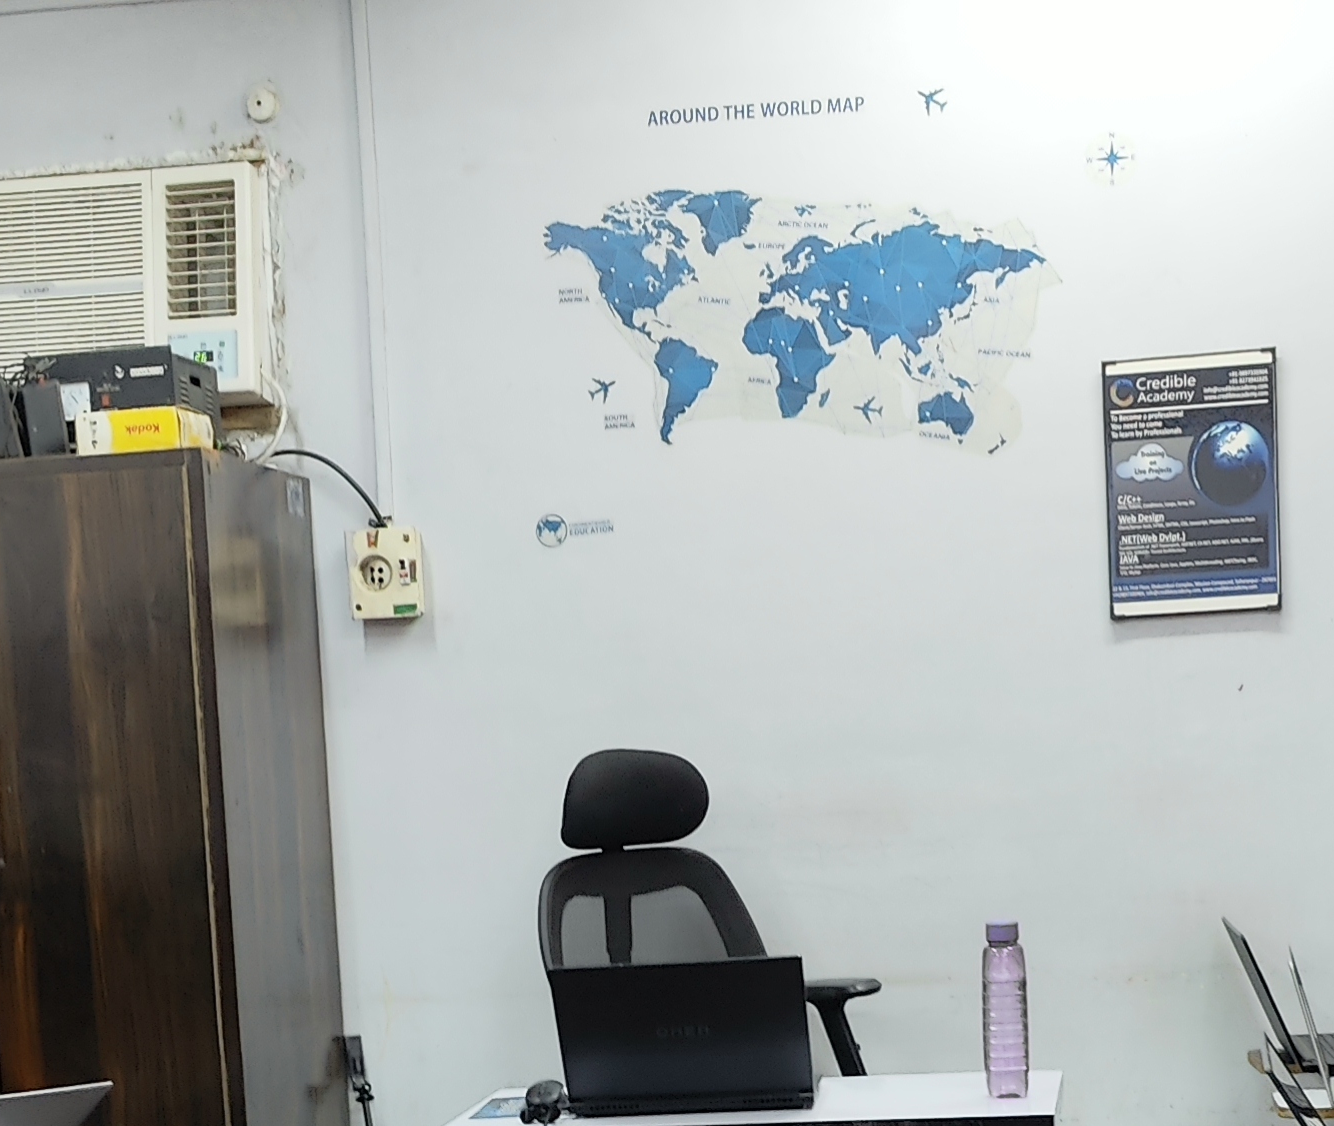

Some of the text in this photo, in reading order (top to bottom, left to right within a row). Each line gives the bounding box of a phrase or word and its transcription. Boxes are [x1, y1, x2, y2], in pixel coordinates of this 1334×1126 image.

[647, 96, 865, 127] AROUND THE WORLD MAP
[558, 288, 583, 296] NORTH
[697, 296, 731, 305] ATLANTIC
[1006, 350, 1031, 358] OCEAN
[1136, 373, 1197, 391] Credible
[1137, 390, 1195, 403] Academy
[125, 422, 160, 435] Kodak
[1117, 494, 1141, 505] C/C++
[1118, 514, 1136, 524] Web
[1138, 513, 1165, 523] Design
[569, 525, 614, 536] EDUCATION
[1119, 554, 1139, 565] JAVA
